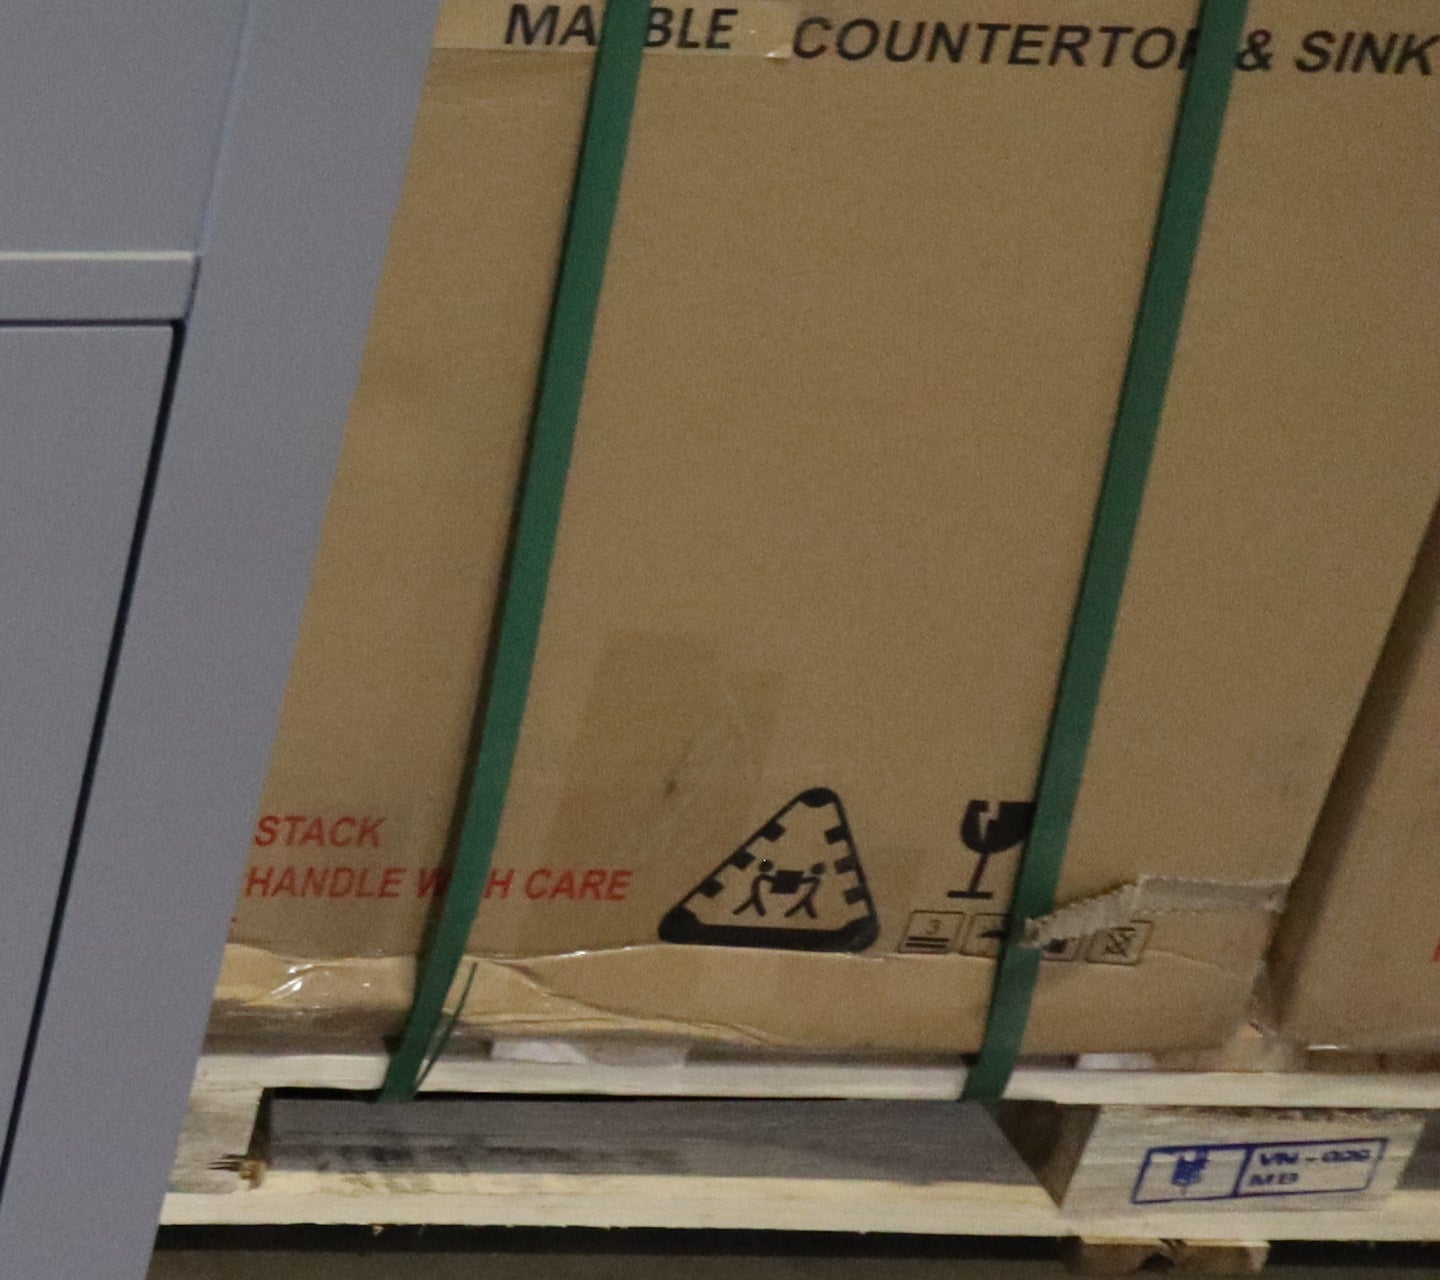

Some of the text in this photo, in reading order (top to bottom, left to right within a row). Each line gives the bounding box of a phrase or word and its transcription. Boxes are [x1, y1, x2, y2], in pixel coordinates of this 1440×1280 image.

[504, 3, 740, 51] MABLE
[1235, 28, 1273, 72] &
[1294, 30, 1440, 76] SINK
[254, 814, 387, 848] STACK
[244, 866, 634, 901] HANDLE WH CARE
